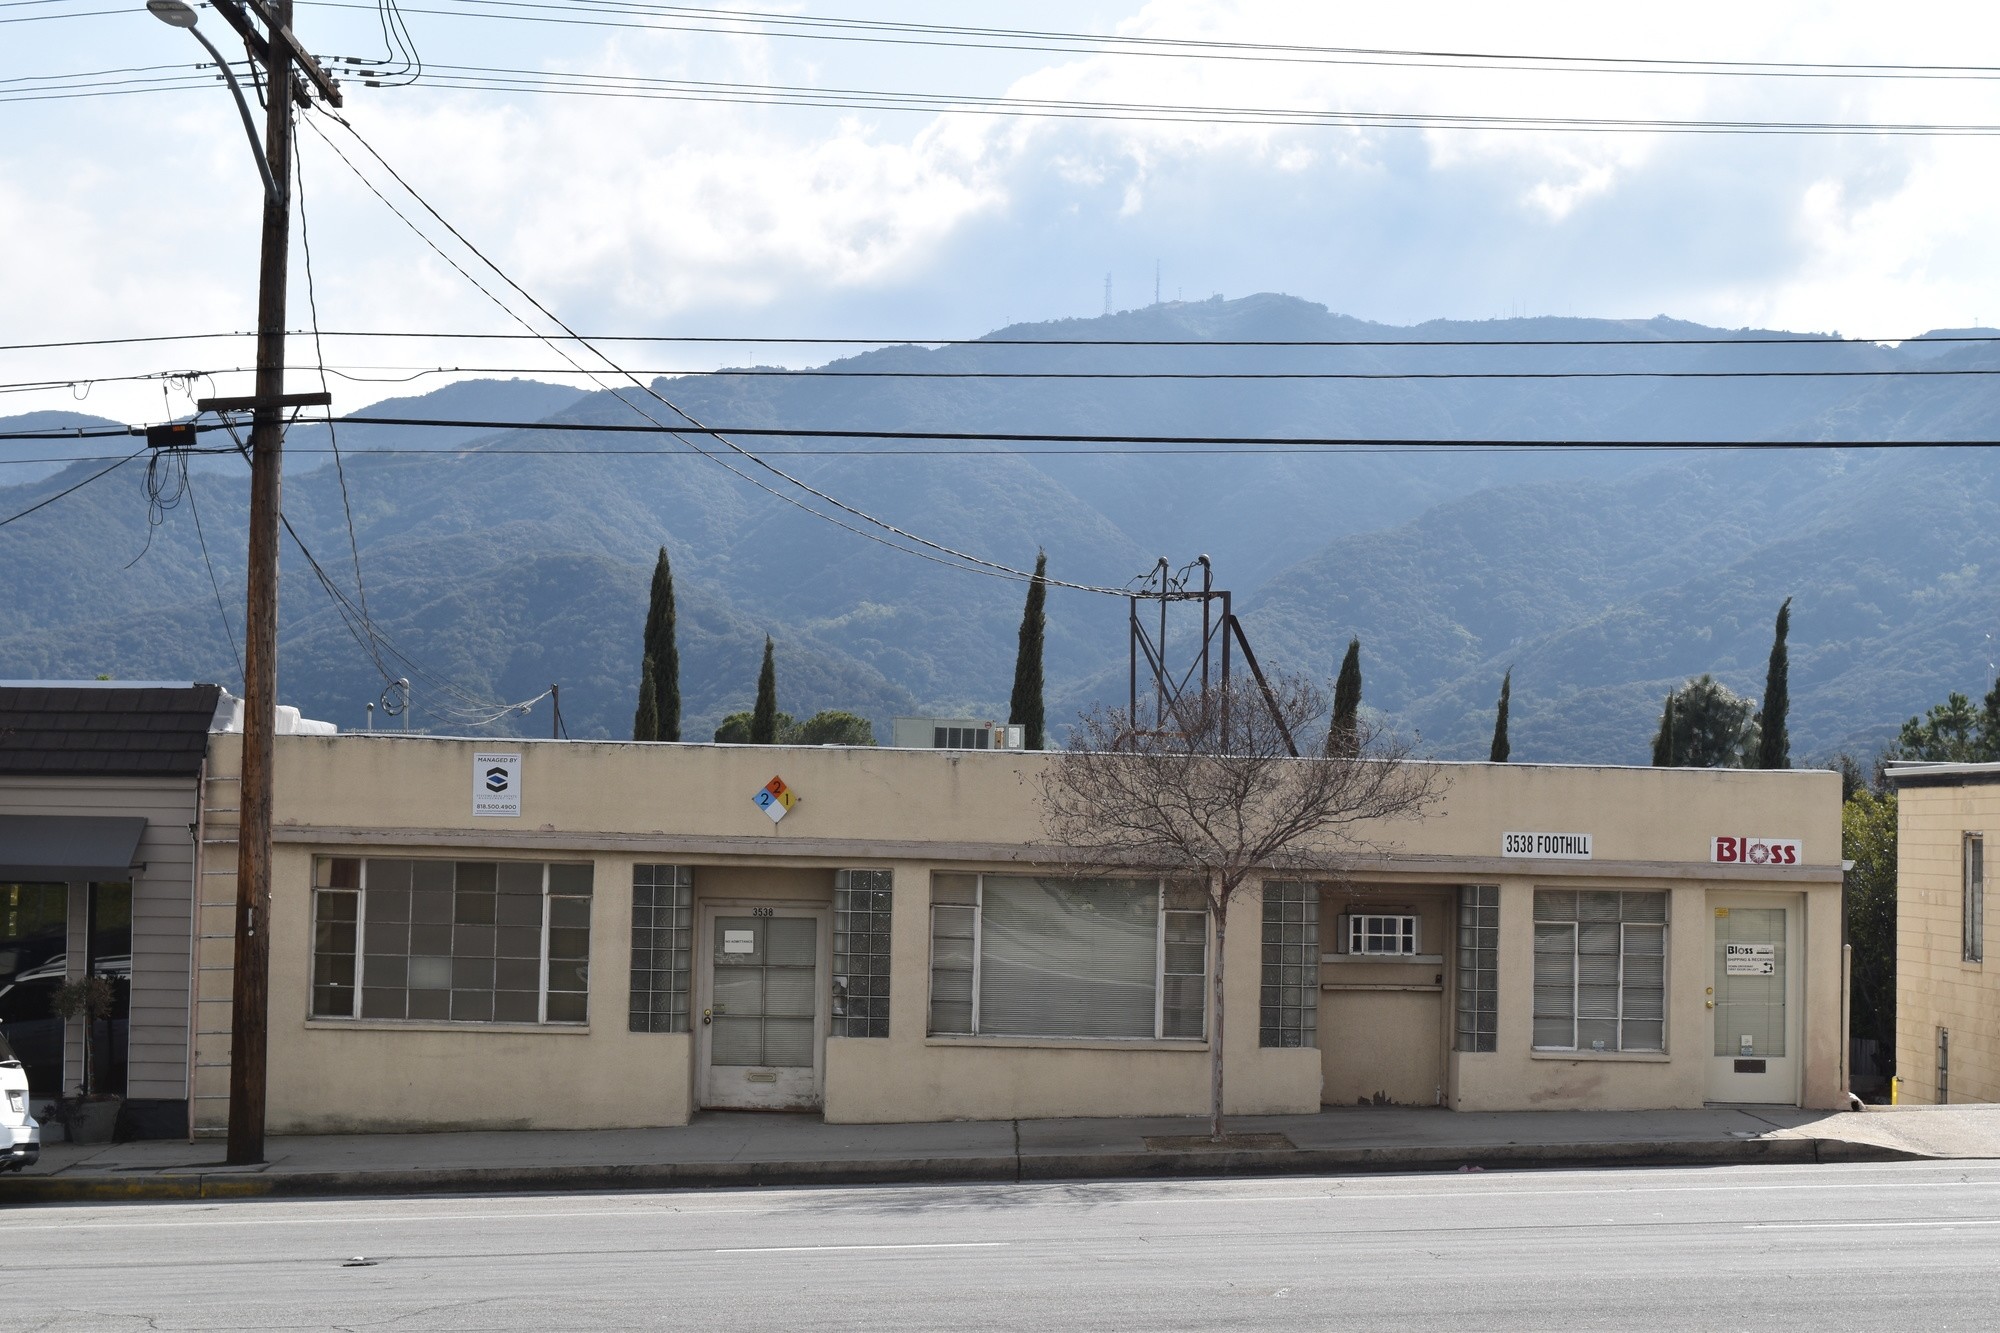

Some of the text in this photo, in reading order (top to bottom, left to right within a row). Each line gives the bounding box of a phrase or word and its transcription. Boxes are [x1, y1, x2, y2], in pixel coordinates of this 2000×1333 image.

[773, 781, 781, 793] 2
[760, 793, 769, 805] 2
[785, 793, 789, 805] 1
[1506, 834, 1589, 854] 3538 FOOTHILL
[1716, 837, 1796, 864] Bloss
[752, 907, 774, 917] 3538
[1727, 946, 1753, 954] Bloss
